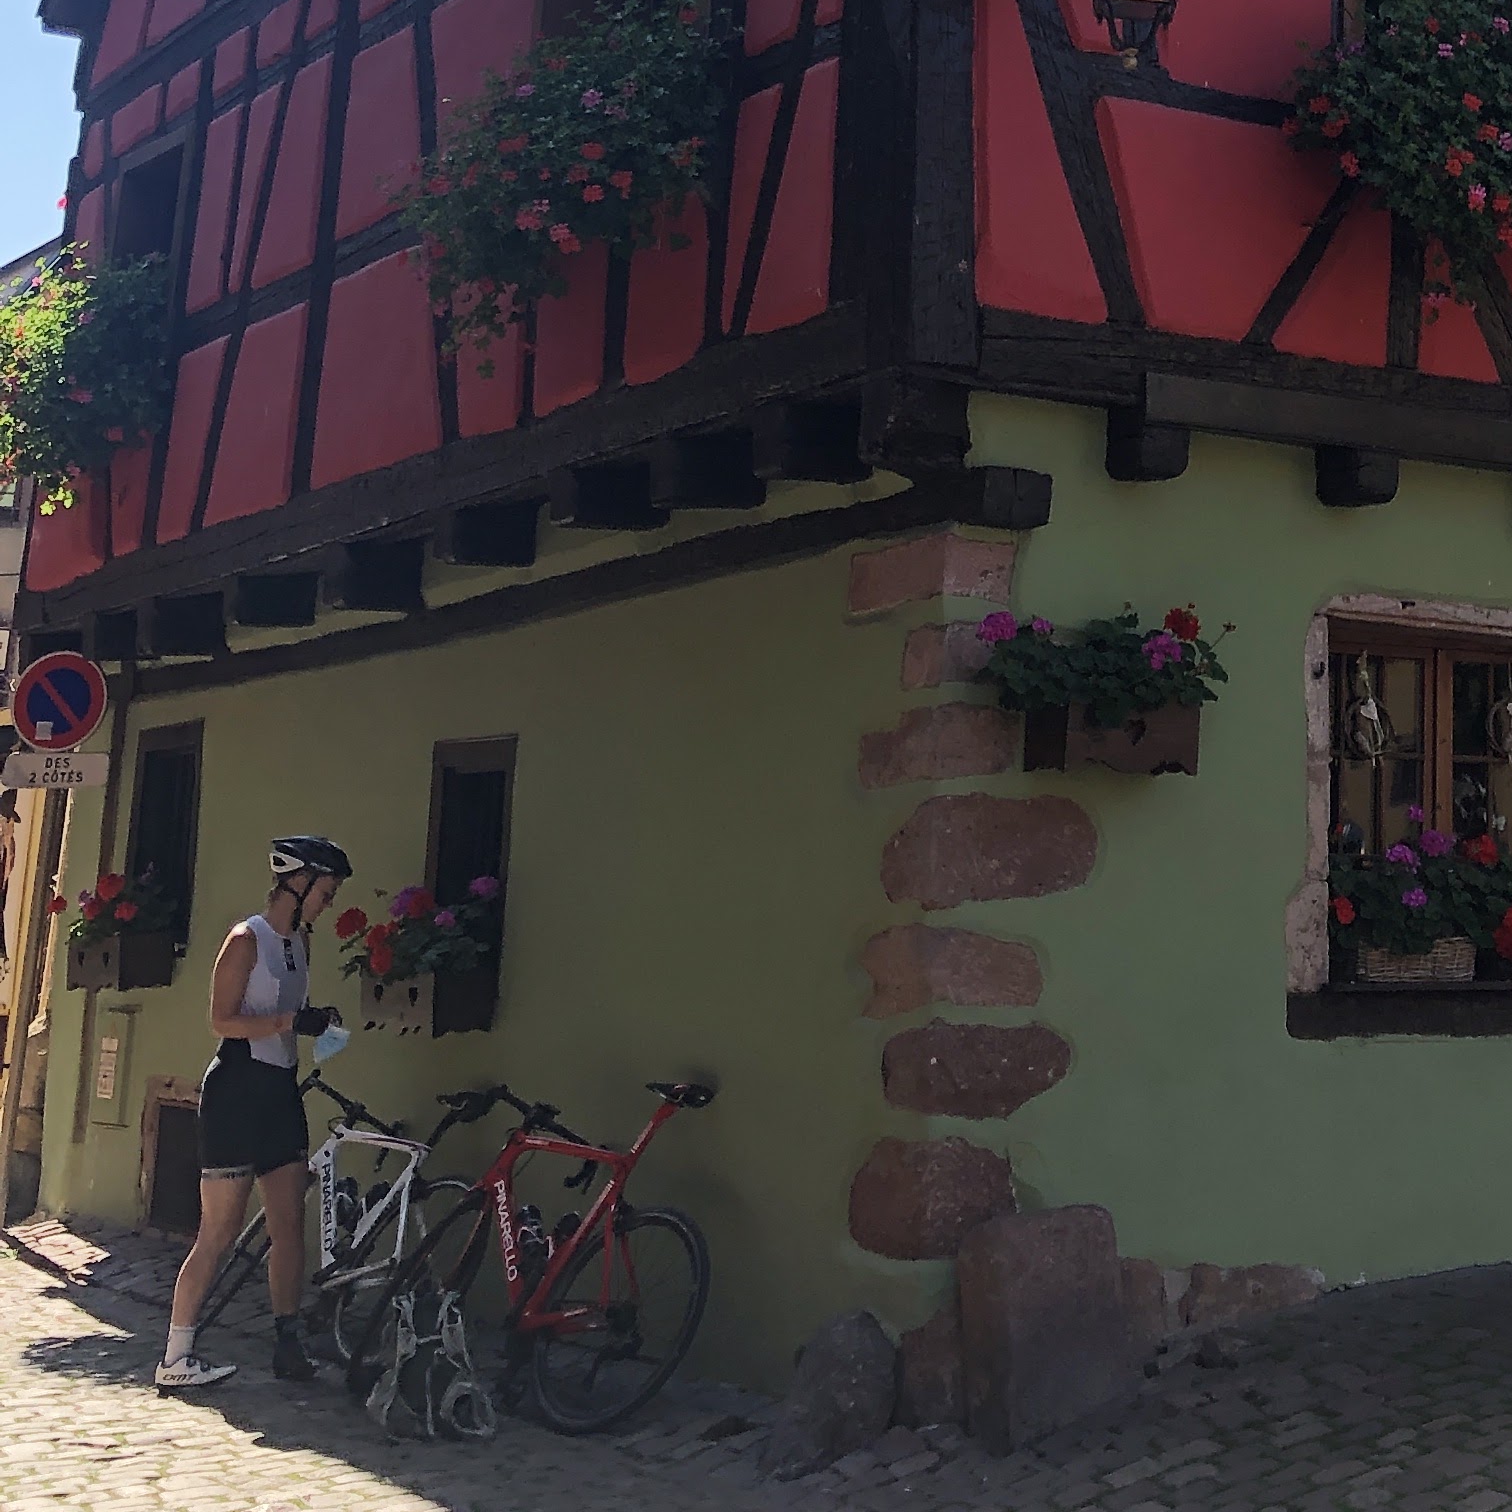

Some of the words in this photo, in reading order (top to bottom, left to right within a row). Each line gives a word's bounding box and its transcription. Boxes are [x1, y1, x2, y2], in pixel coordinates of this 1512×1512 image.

[29, 772, 36, 783] 2
[42, 769, 83, 783] CÔTÉS
[45, 757, 70, 769] DES
[321, 1163, 333, 1252] PINARELLO
[494, 1179, 518, 1282] PINARELLO
